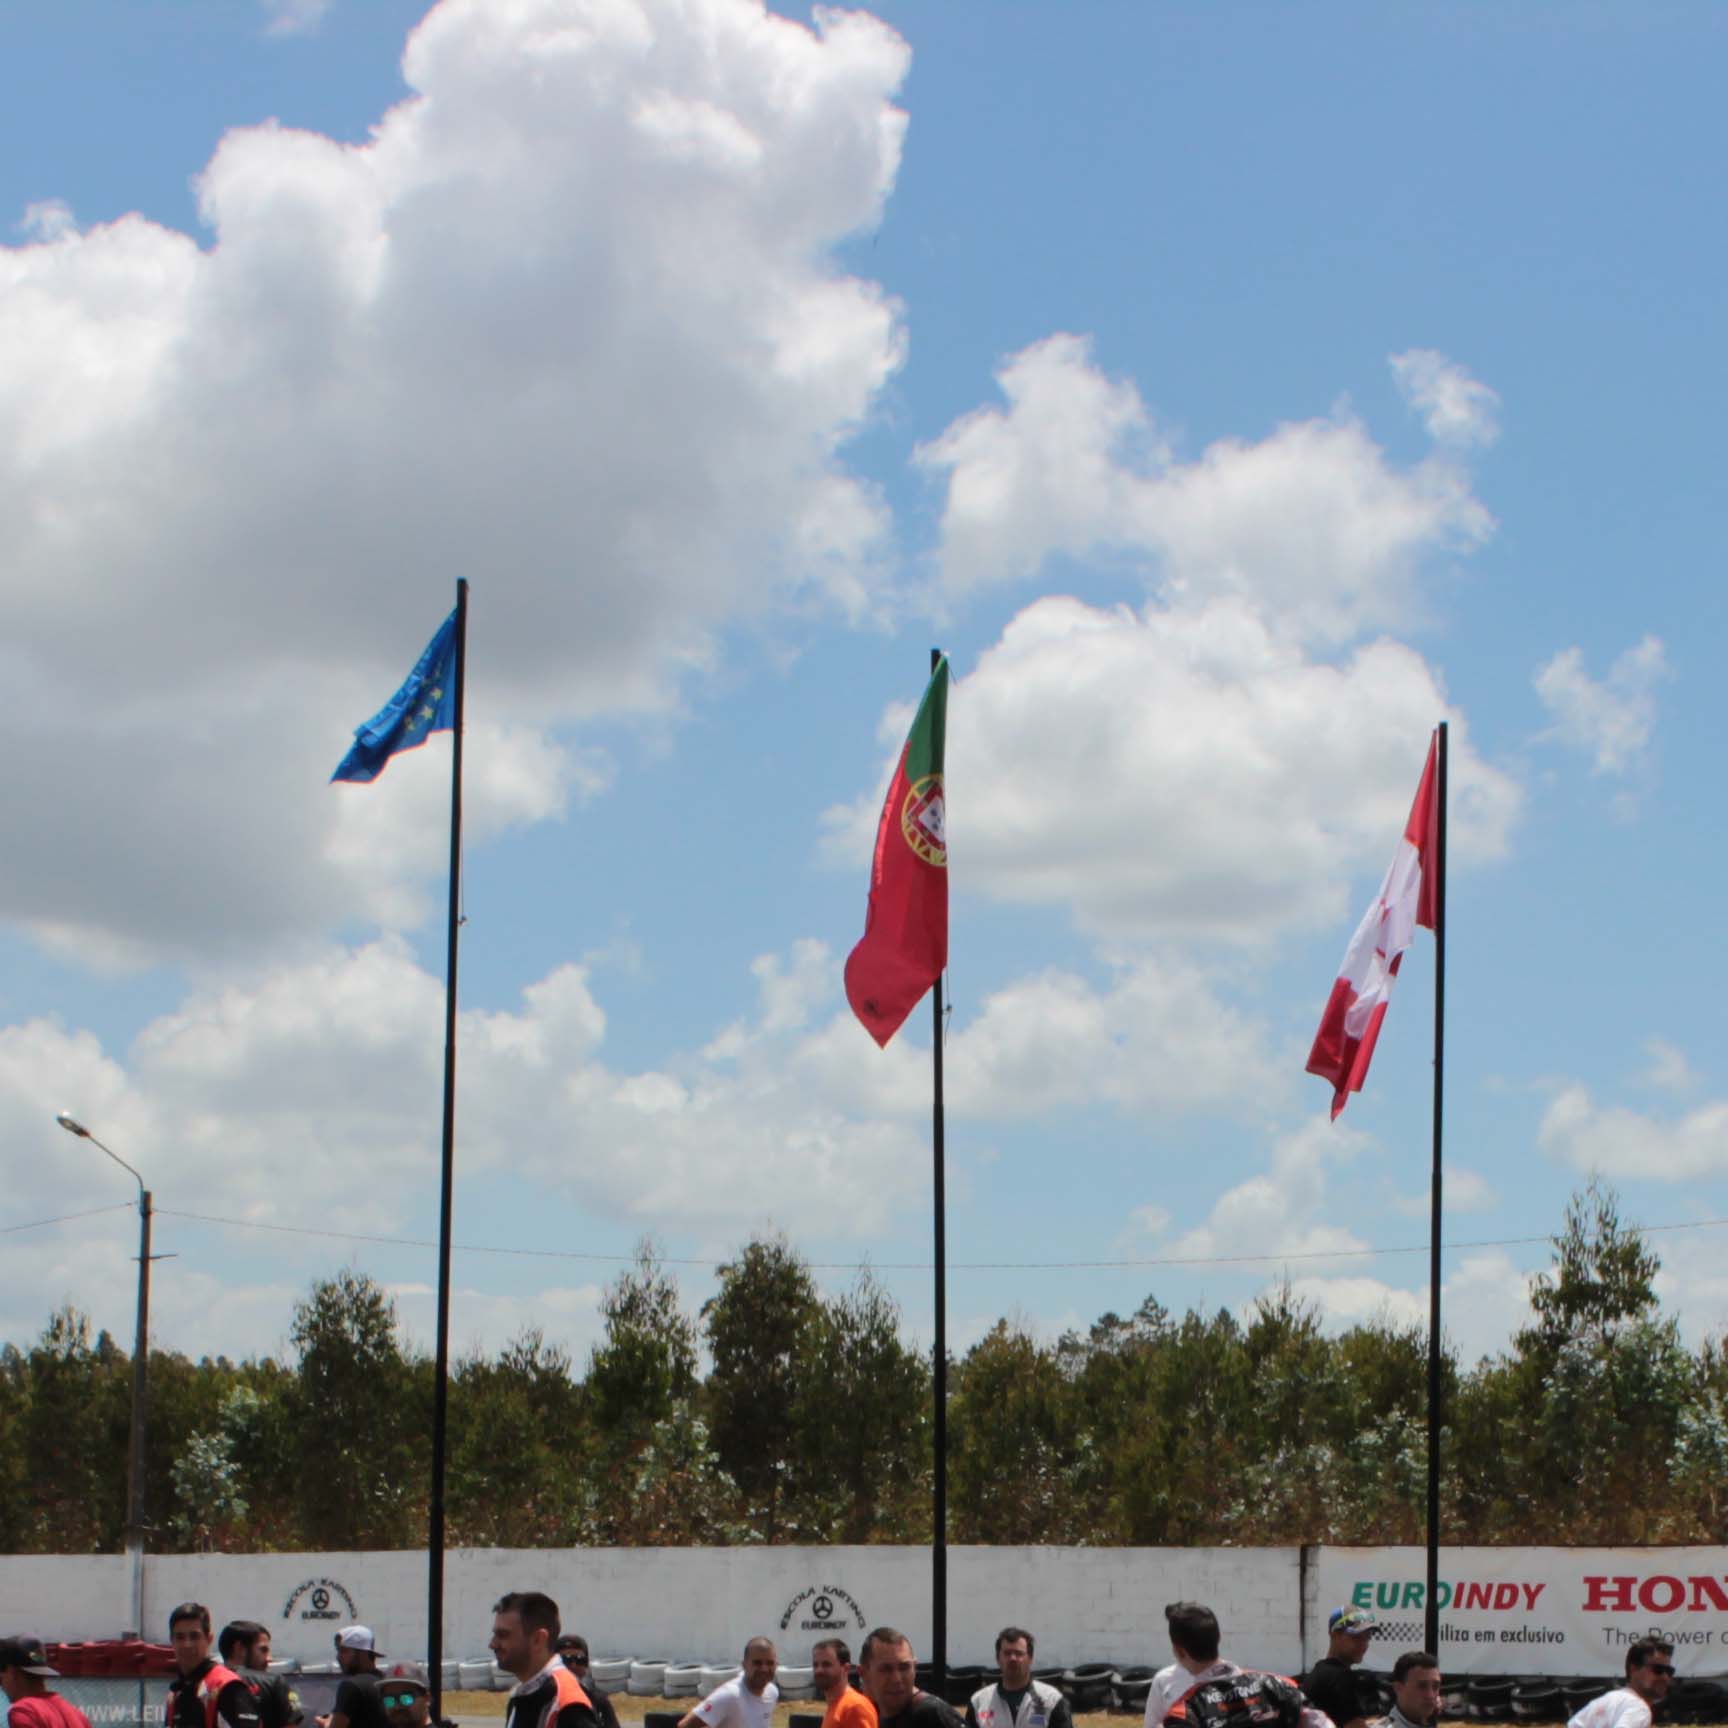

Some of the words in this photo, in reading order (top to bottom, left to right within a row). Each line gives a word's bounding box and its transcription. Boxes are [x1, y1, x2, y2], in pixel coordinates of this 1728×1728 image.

[780, 1586, 816, 1630] ESCOLA
[823, 1584, 866, 1630] KARTING
[1351, 1581, 1547, 1611] EUROINDY
[1474, 1629, 1495, 1643] em
[1500, 1625, 1565, 1644] exclusivo
[1603, 1627, 1640, 1646] The
